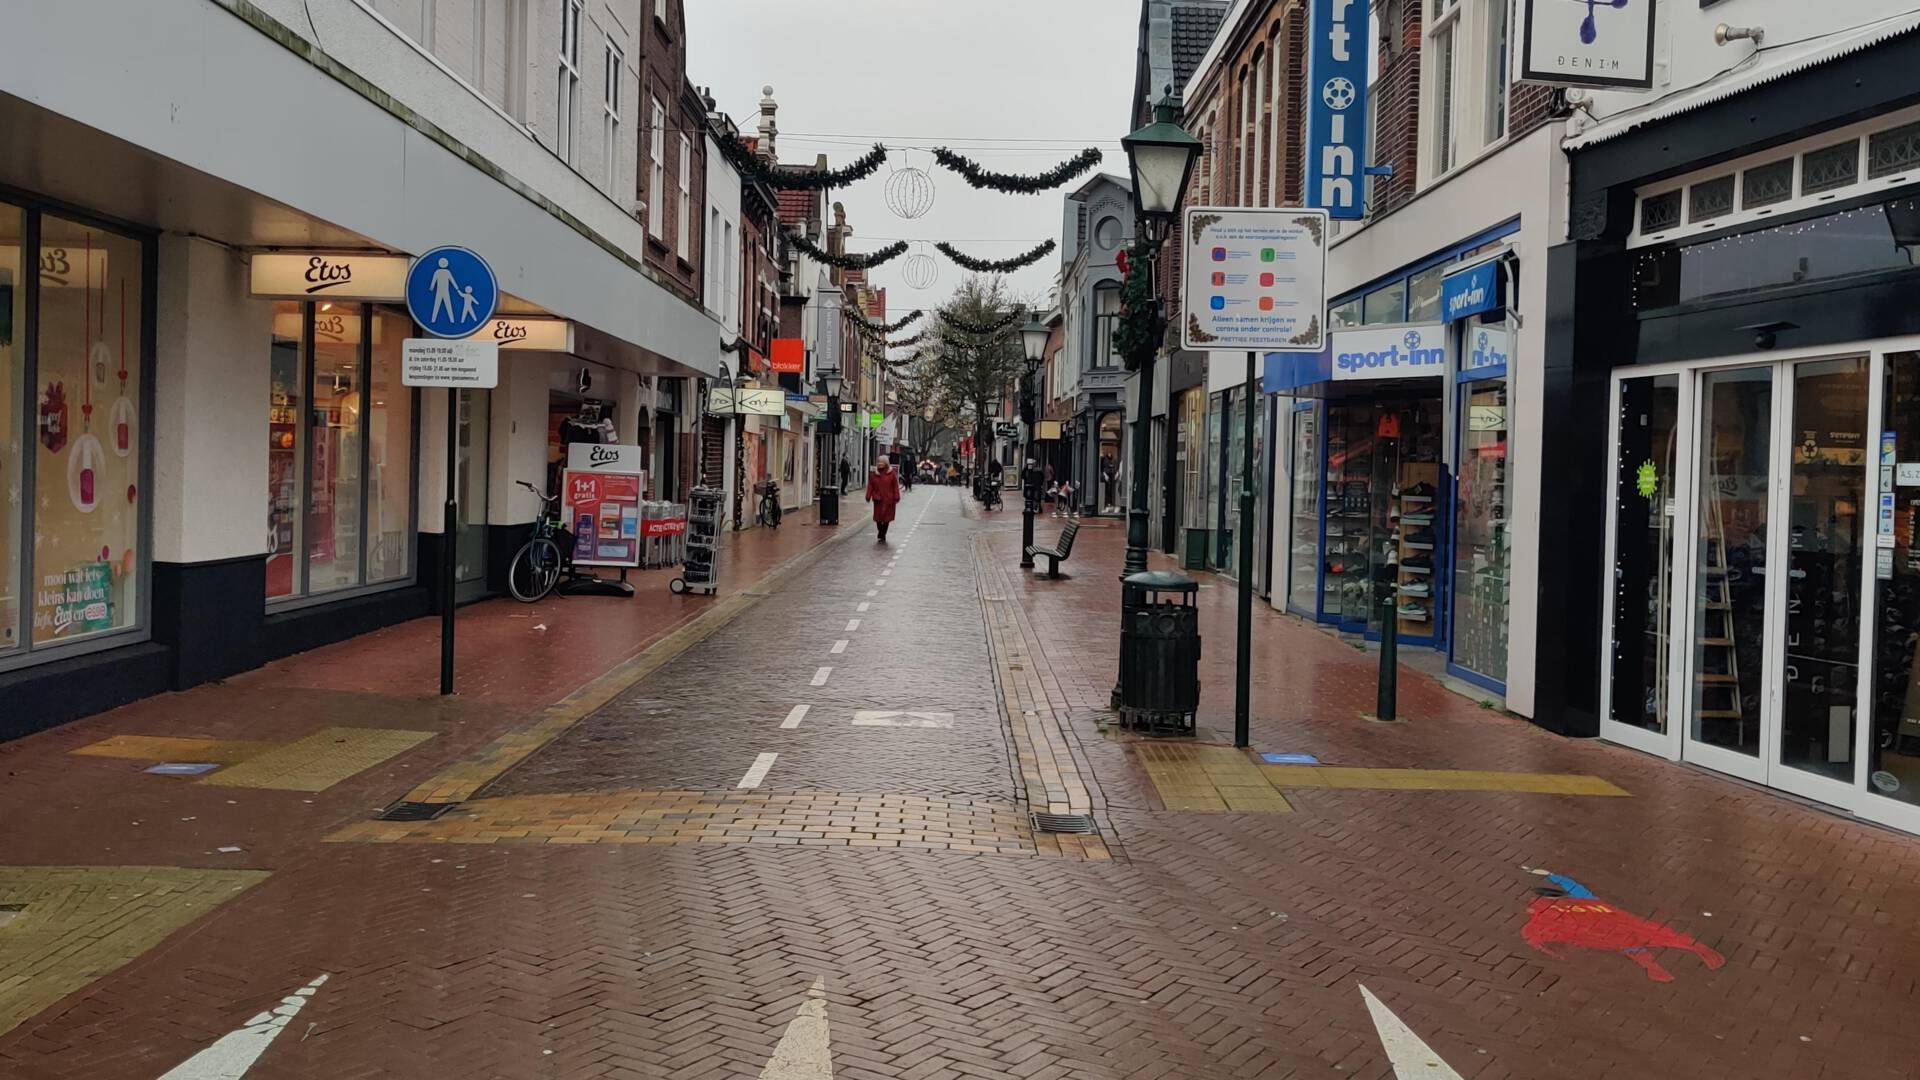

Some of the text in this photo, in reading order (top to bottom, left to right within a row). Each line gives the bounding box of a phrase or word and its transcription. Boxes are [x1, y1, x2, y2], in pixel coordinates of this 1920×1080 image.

[304, 256, 352, 283] Etos
[493, 321, 527, 339] Etos
[772, 362, 801, 370] blokker
[1337, 344, 1445, 373] sport-inn
[590, 446, 620, 463] Etos
[574, 479, 596, 493] 1+1
[573, 492, 596, 501] gratis
[44, 573, 67, 587] mooi
[38, 586, 105, 607] kleins kan doen
